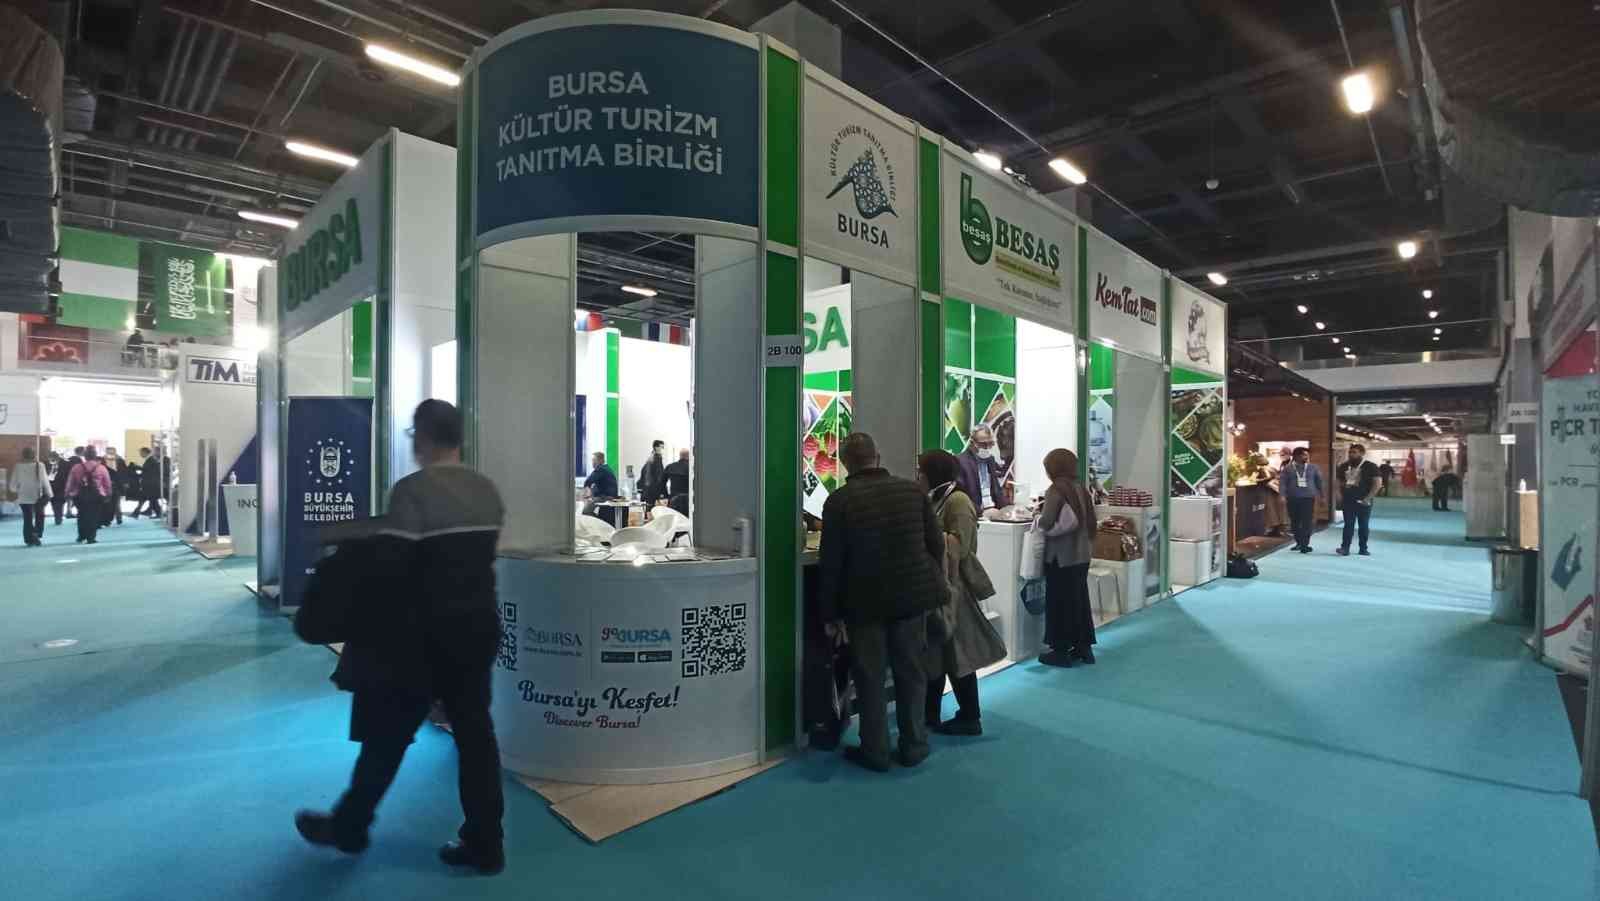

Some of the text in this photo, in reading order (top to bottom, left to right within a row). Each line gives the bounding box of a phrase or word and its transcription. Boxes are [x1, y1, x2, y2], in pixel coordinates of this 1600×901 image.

[548, 71, 649, 99] BURSA
[499, 104, 718, 147] KÜLTÜR TURİZM
[496, 138, 723, 182] TANITMA BİRLİĞİ
[837, 213, 890, 249] BURSA
[995, 217, 1060, 275] BESAŞ
[285, 198, 363, 312] BURSA
[1095, 272, 1140, 317] KemTat
[768, 346, 802, 356] 2B 100
[304, 492, 354, 503] BURSA
[517, 679, 681, 717] Bursa'yı Keşfet!
[543, 710, 641, 729] Discover Bursa!
